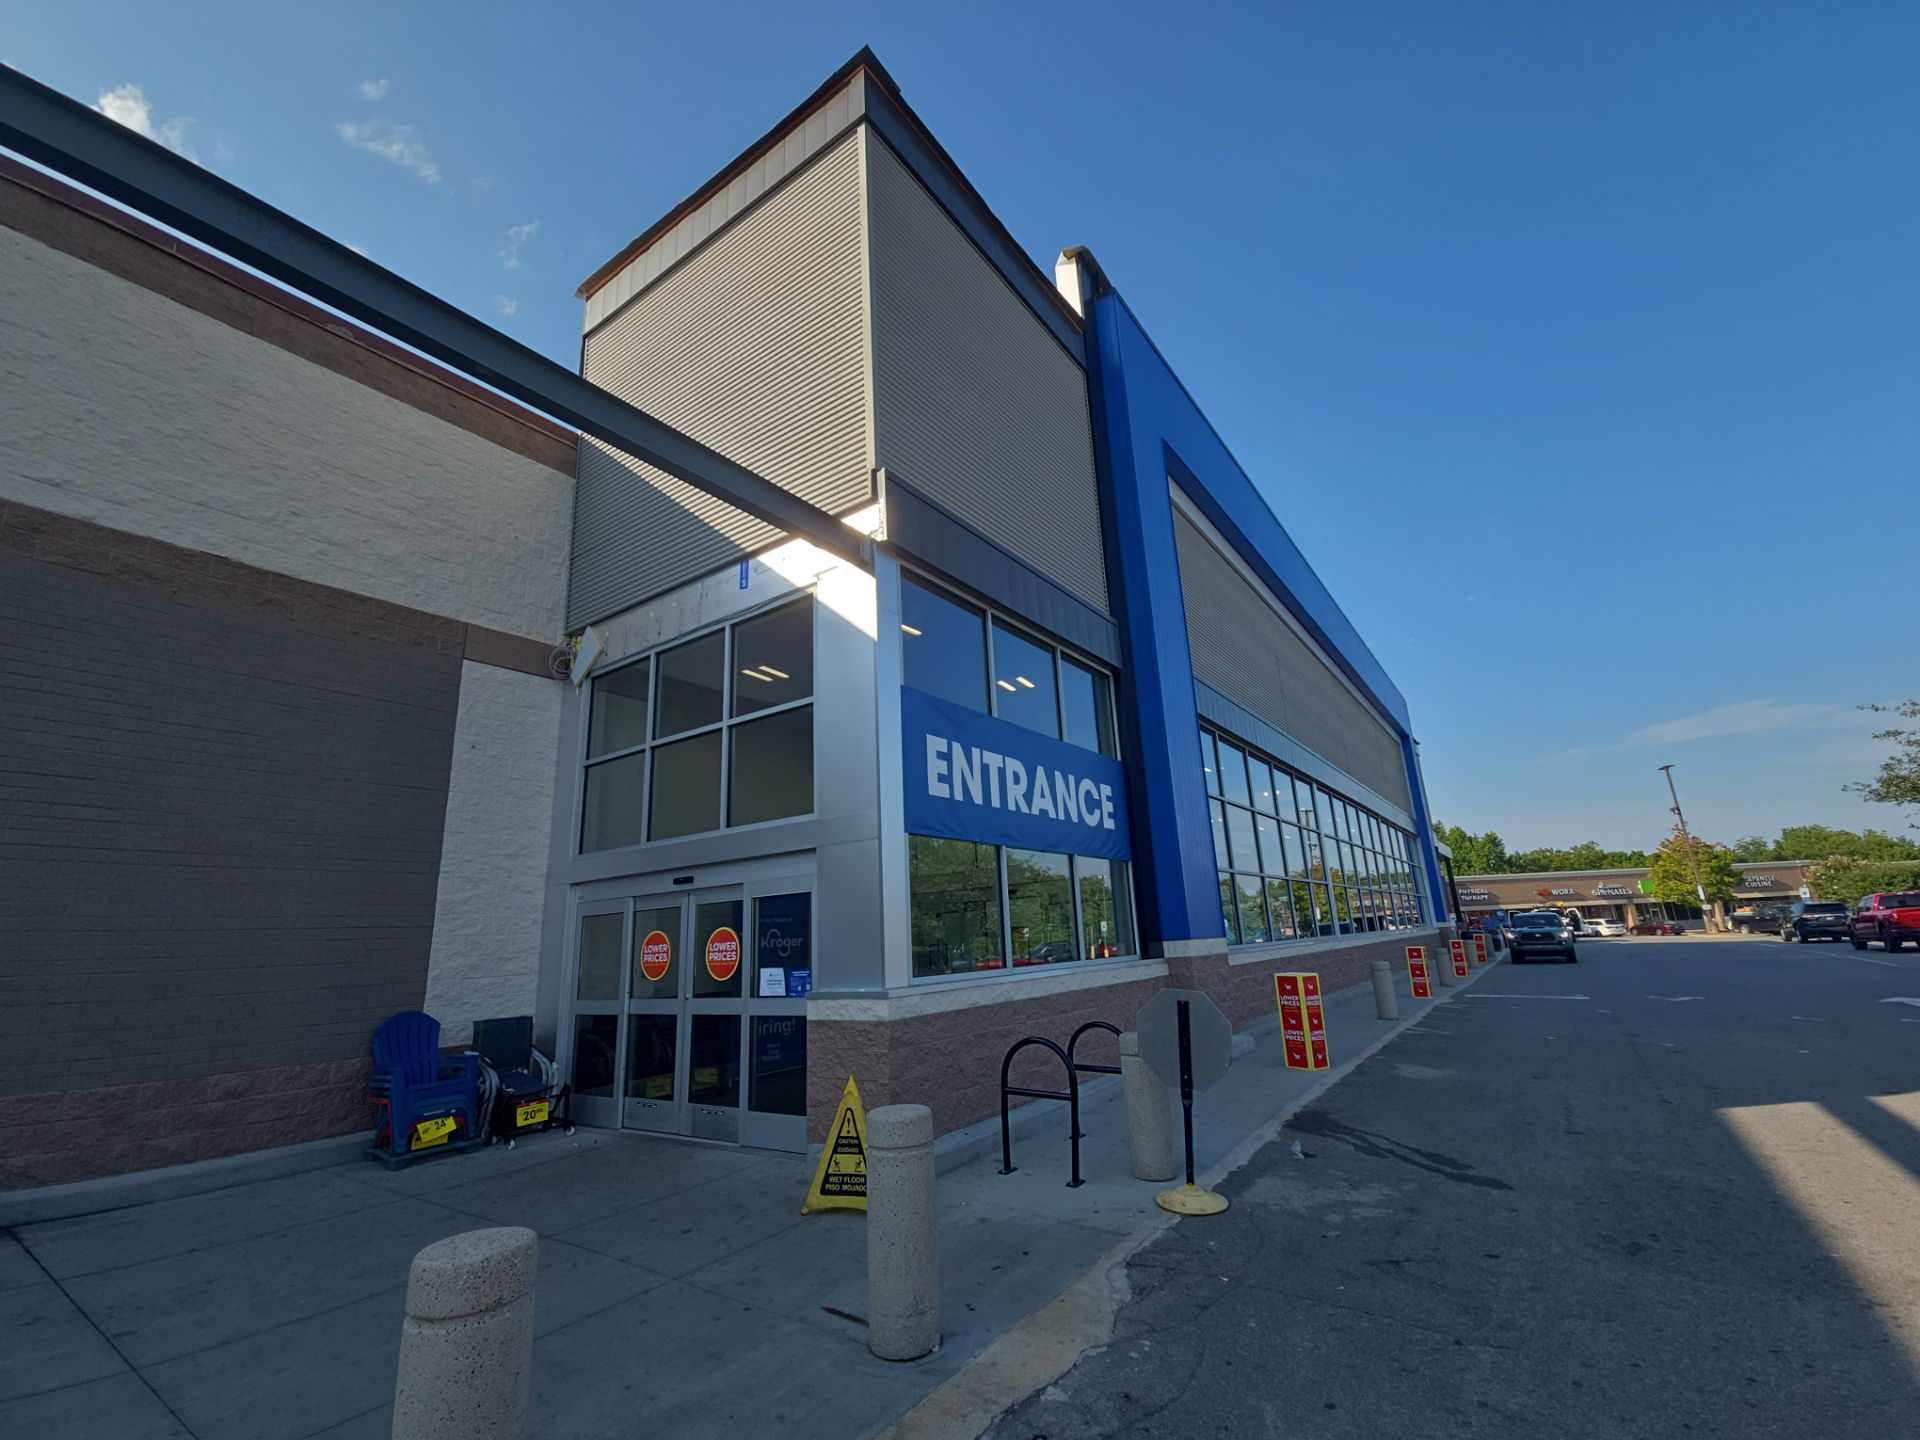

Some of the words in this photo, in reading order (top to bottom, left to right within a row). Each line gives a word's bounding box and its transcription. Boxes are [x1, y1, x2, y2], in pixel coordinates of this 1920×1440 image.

[926, 733, 1115, 830] ENTRANCE
[709, 942, 736, 951] LOWER
[760, 928, 803, 957] Kroger
[644, 944, 668, 953] LOWER
[643, 953, 668, 962] PRICES
[709, 951, 736, 961] PRICES
[758, 1016, 796, 1036] iring!
